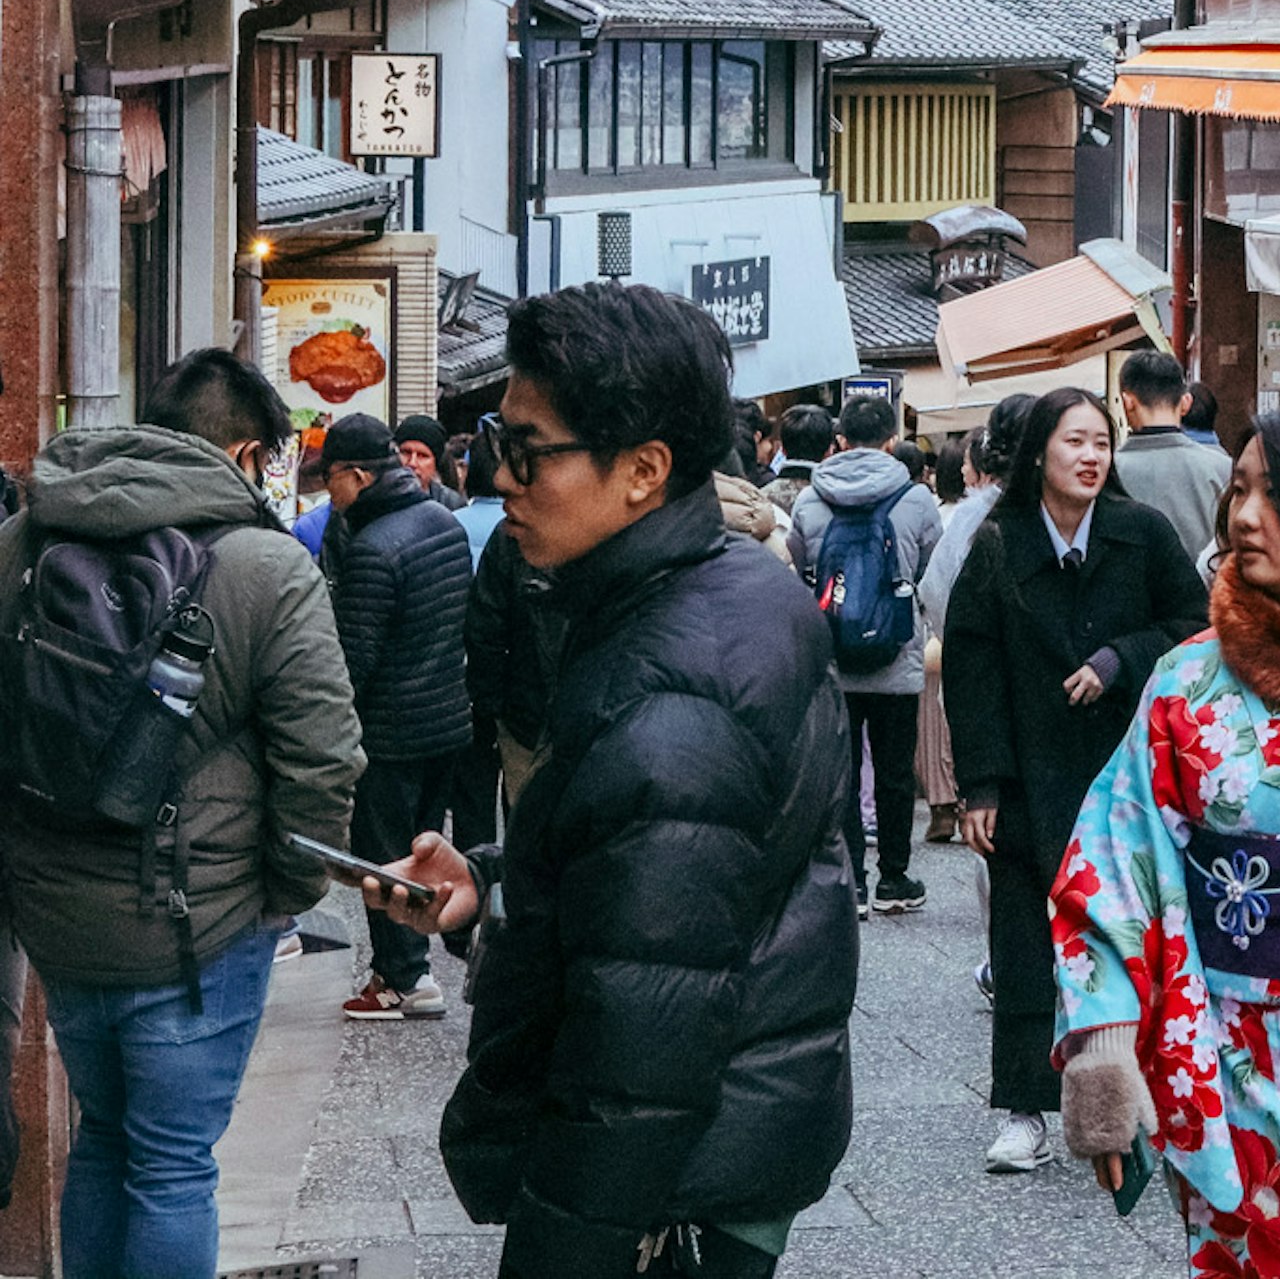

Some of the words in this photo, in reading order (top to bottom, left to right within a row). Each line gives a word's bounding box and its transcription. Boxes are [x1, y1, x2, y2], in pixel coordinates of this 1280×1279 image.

[381, 60, 408, 140] とんかつ
[415, 63, 431, 98] 名物
